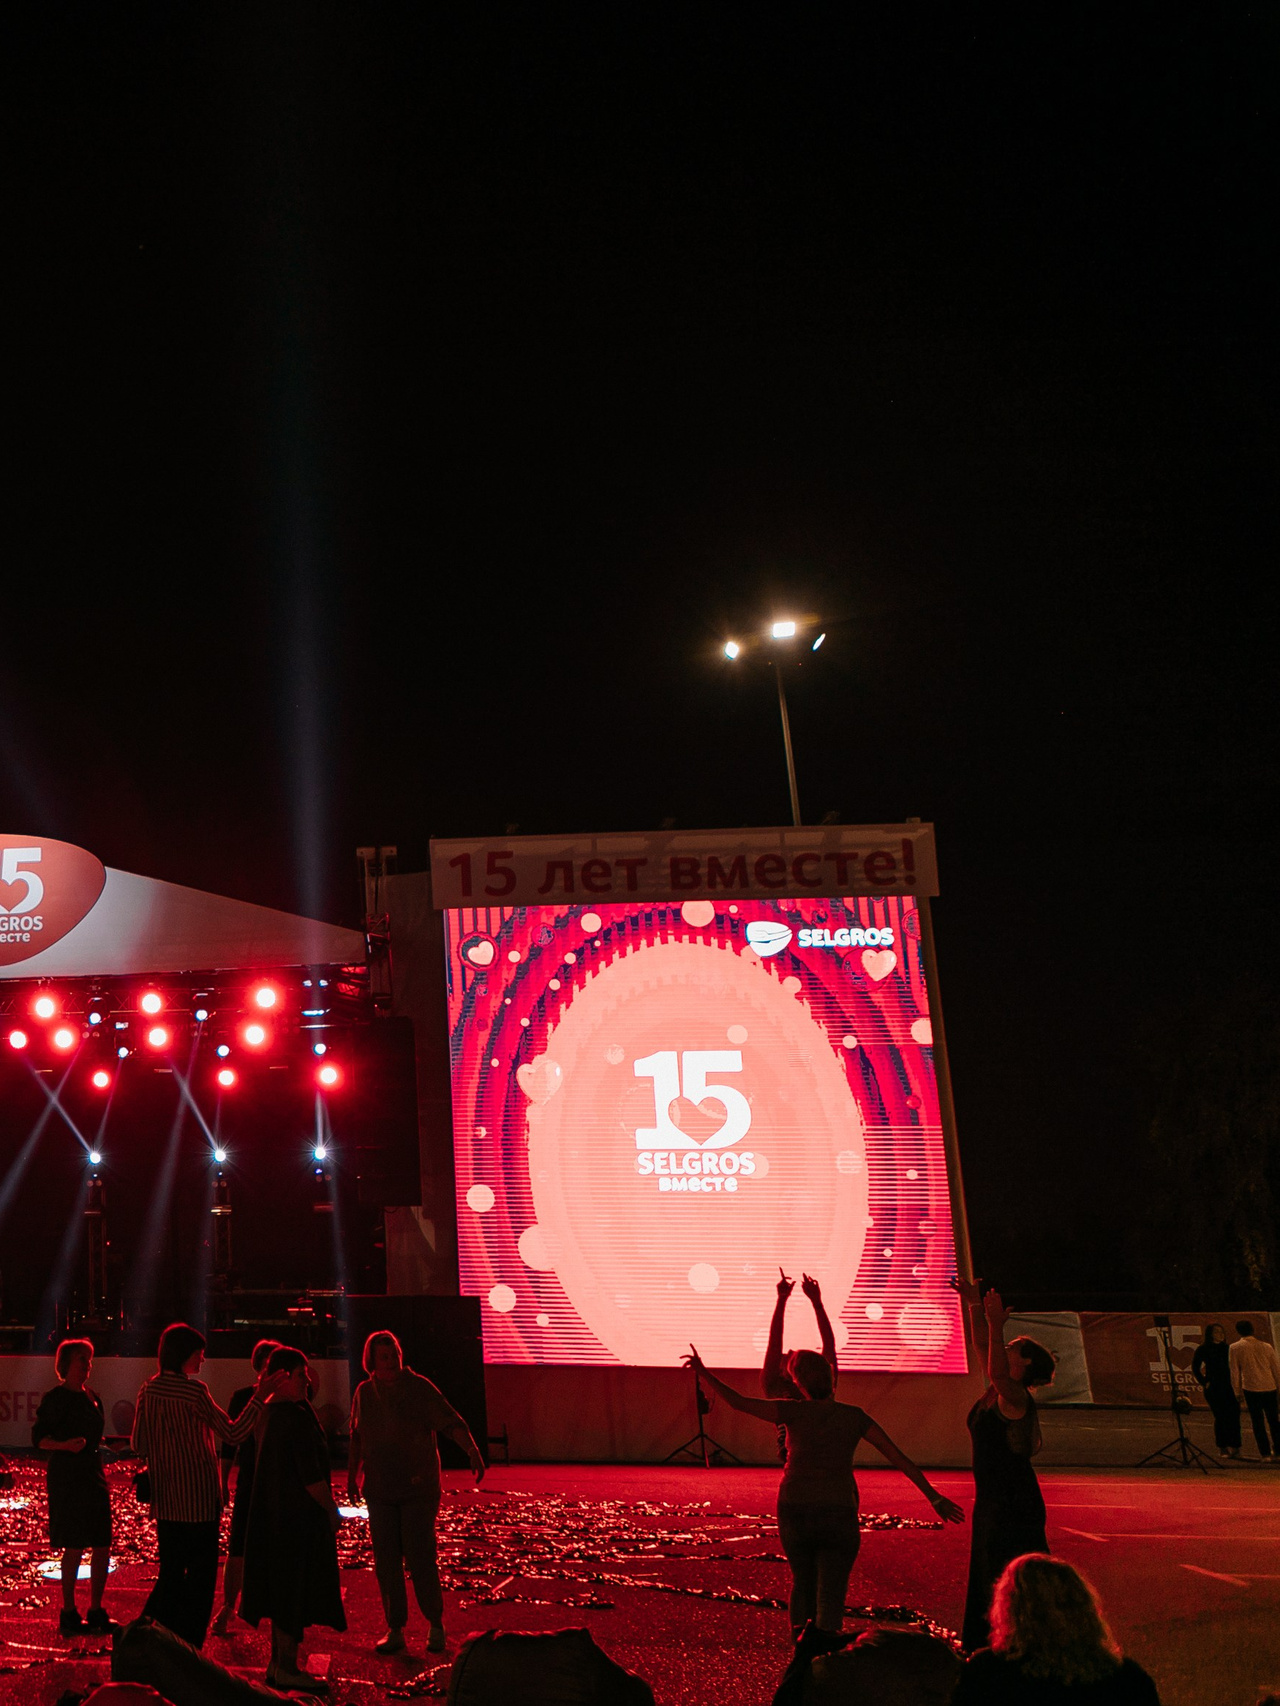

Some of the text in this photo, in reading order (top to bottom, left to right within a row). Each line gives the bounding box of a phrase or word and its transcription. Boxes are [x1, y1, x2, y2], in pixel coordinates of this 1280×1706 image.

[448, 838, 917, 896] 15 лет вместе!
[798, 927, 895, 947] SELGROS
[633, 1050, 752, 1150] 15
[637, 1151, 756, 1175] SELGROS
